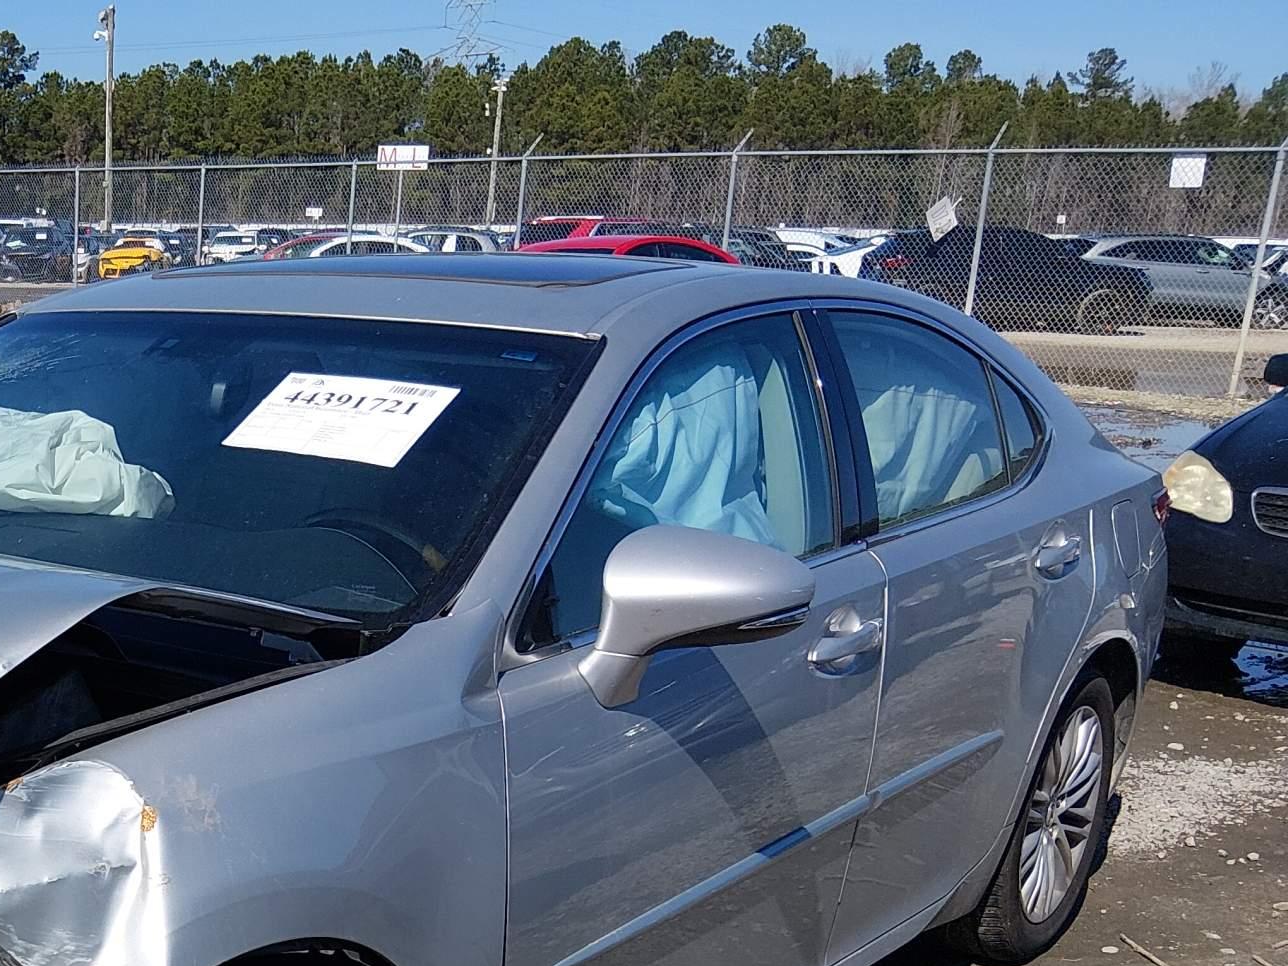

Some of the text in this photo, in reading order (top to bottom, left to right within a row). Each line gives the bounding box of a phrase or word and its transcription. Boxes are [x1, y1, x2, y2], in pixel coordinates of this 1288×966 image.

[379, 147, 421, 168] M L
[284, 390, 419, 415] 44391721
